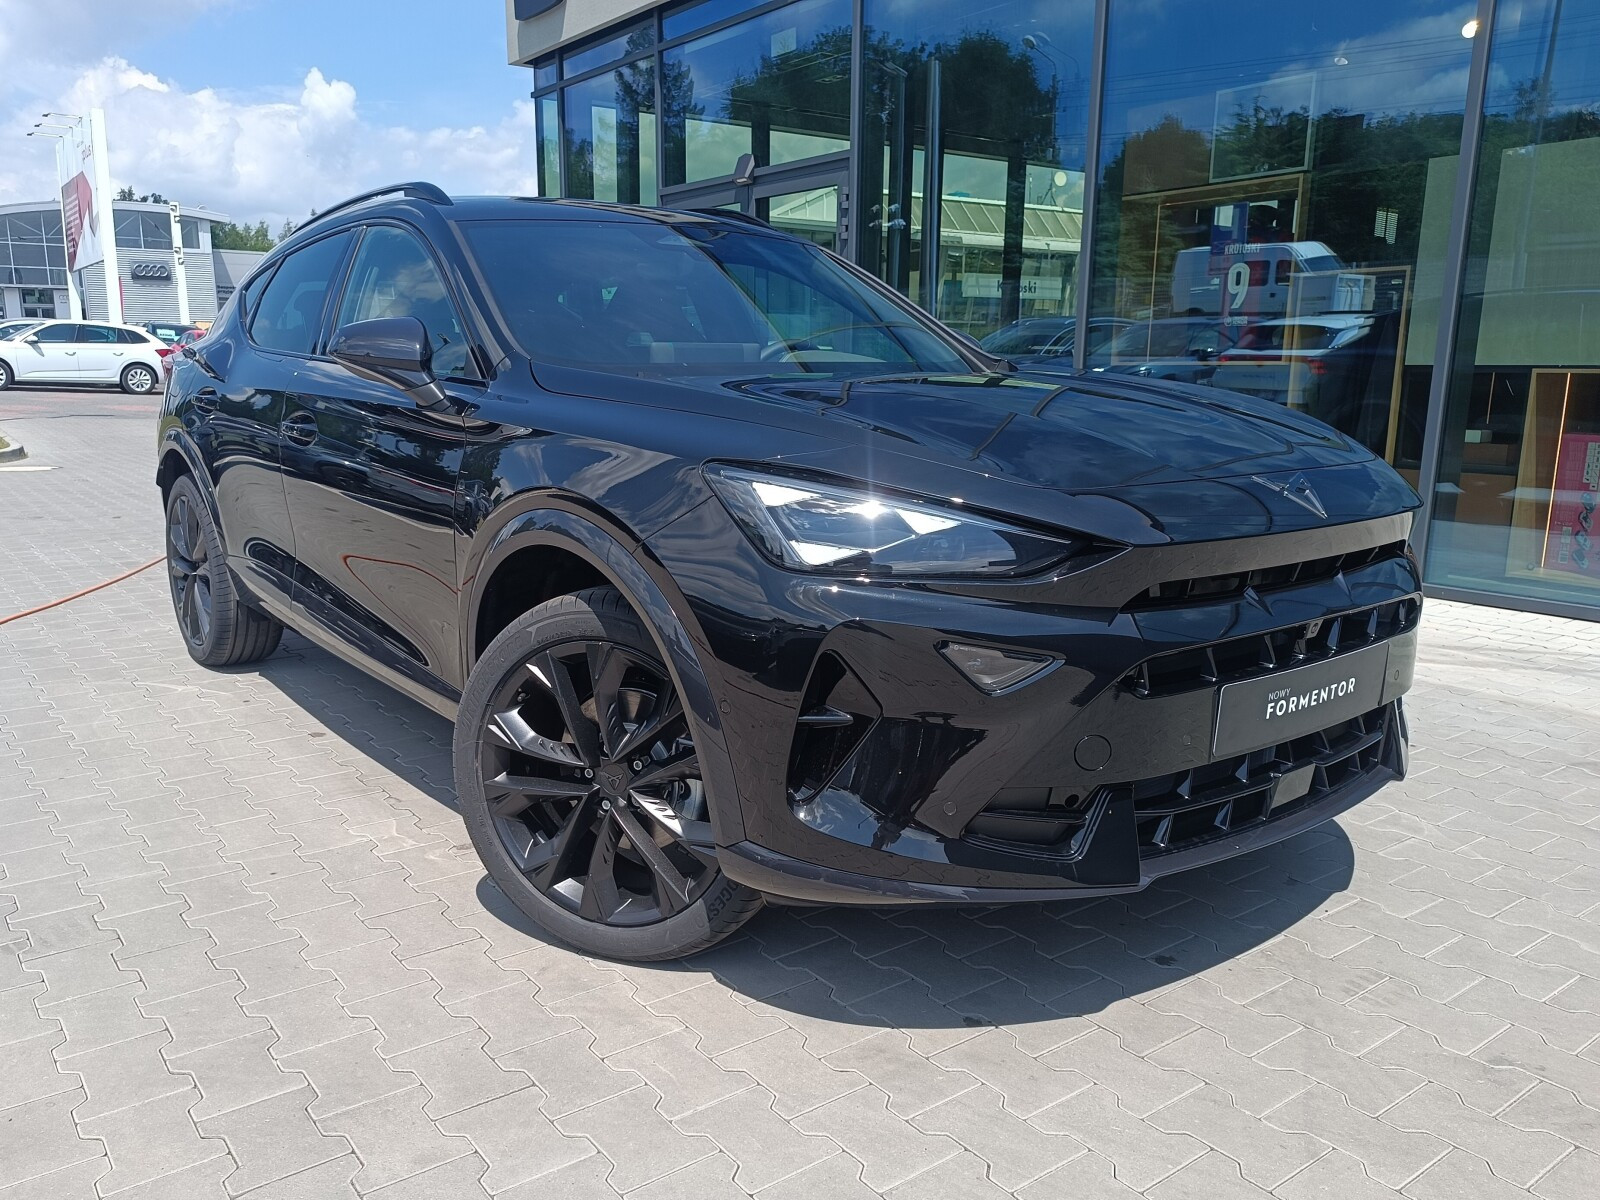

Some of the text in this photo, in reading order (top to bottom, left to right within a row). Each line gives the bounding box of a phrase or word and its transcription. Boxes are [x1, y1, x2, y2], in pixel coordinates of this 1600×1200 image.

[997, 280, 1037, 294] Koski
[1228, 262, 1250, 308] 9
[1266, 677, 1356, 720] FORMENTOR
[1268, 687, 1291, 702] NOWY
